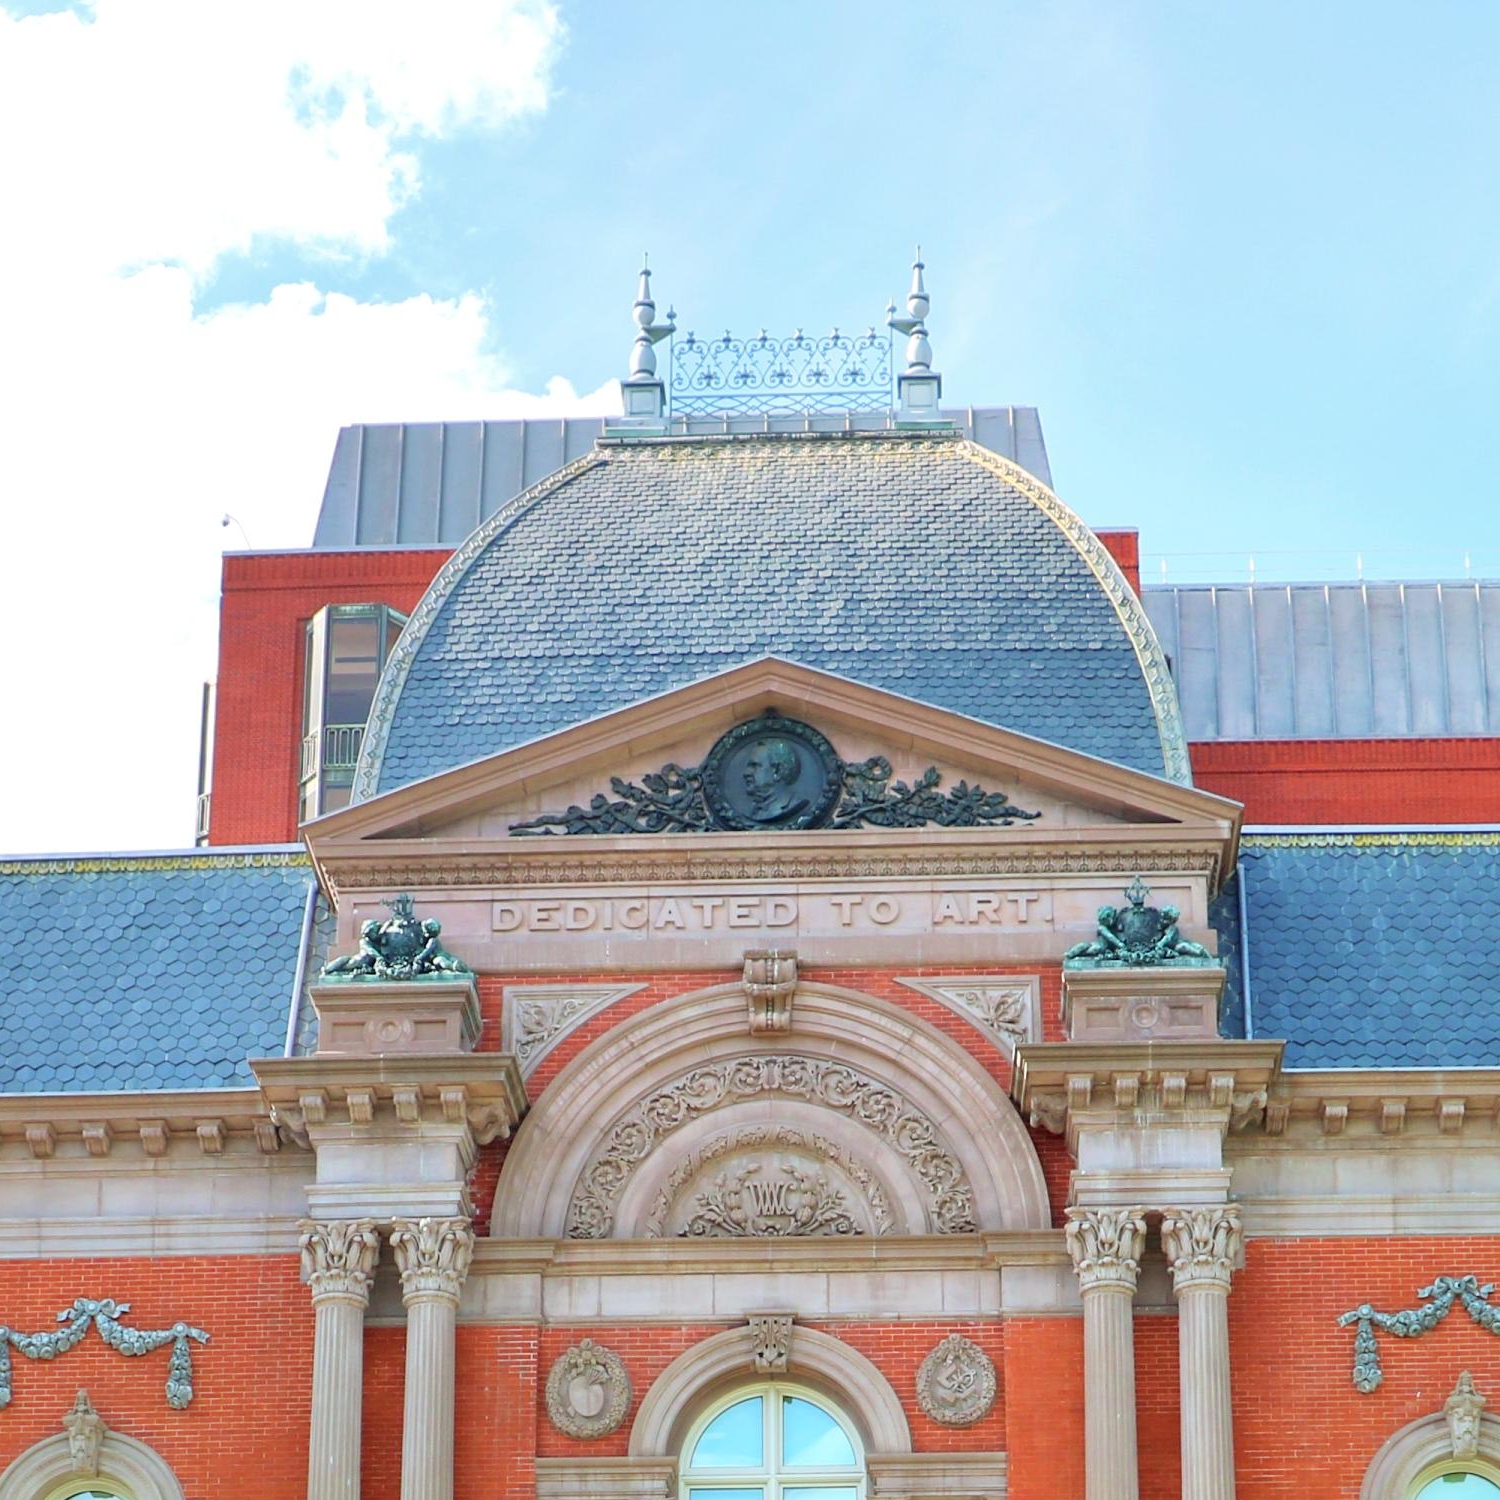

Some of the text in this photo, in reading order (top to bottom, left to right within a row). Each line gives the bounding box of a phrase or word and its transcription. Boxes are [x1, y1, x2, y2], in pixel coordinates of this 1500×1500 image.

[491, 892, 1054, 932] DEDICATED TO ART.
